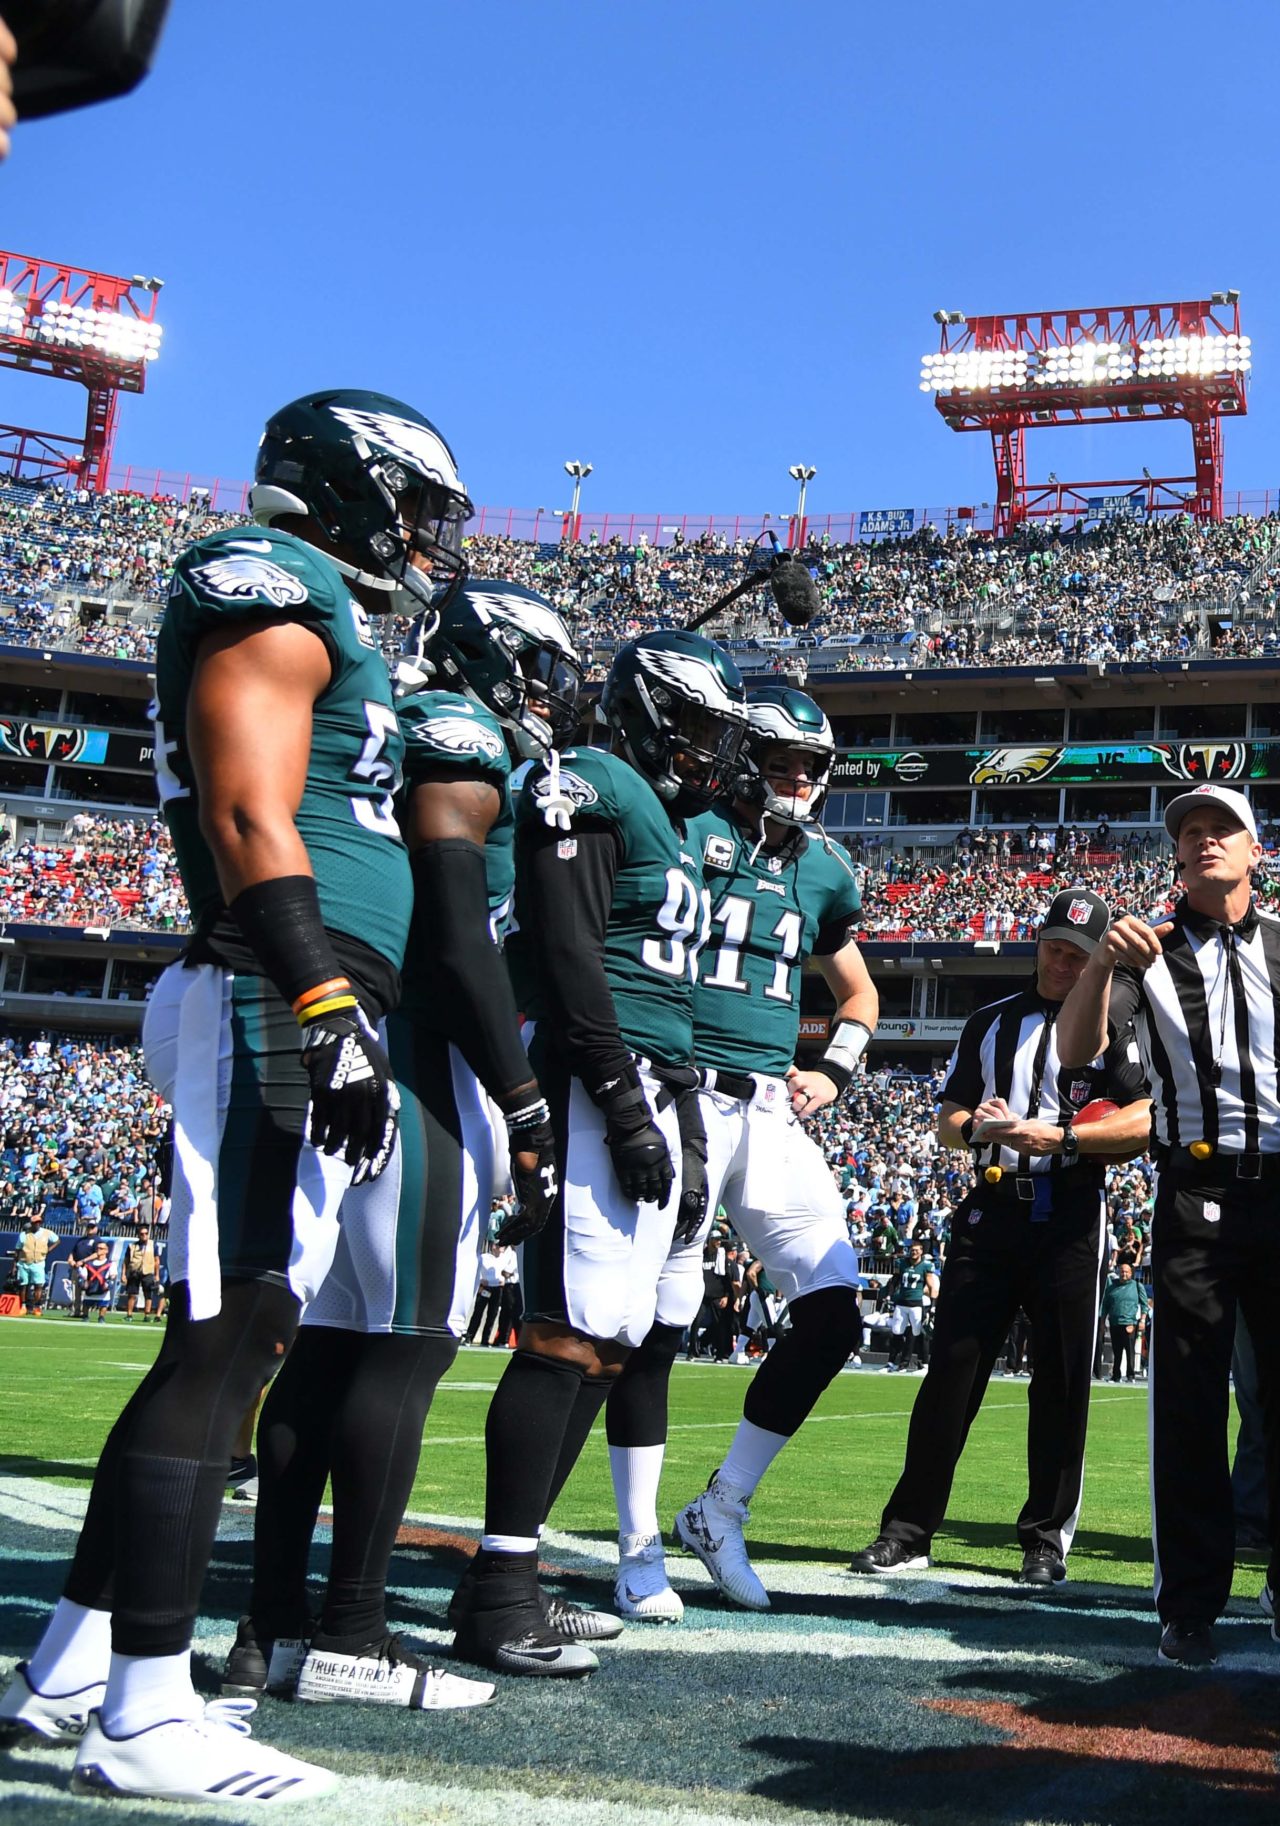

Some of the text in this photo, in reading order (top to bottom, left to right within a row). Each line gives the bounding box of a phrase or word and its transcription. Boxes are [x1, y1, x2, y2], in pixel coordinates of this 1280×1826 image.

[1104, 496, 1130, 507] ELVIN
[867, 511, 884, 522] K.S.
[1088, 506, 1143, 519] BETHEA
[861, 520, 895, 532] ADAMS
[867, 760, 880, 779] by
[702, 895, 803, 1003] 11
[878, 1021, 908, 1032] Young
[0, 1296, 15, 1315] 20
[310, 1658, 339, 1677] TRUE
[340, 1665, 403, 1684] PATRIOTS
